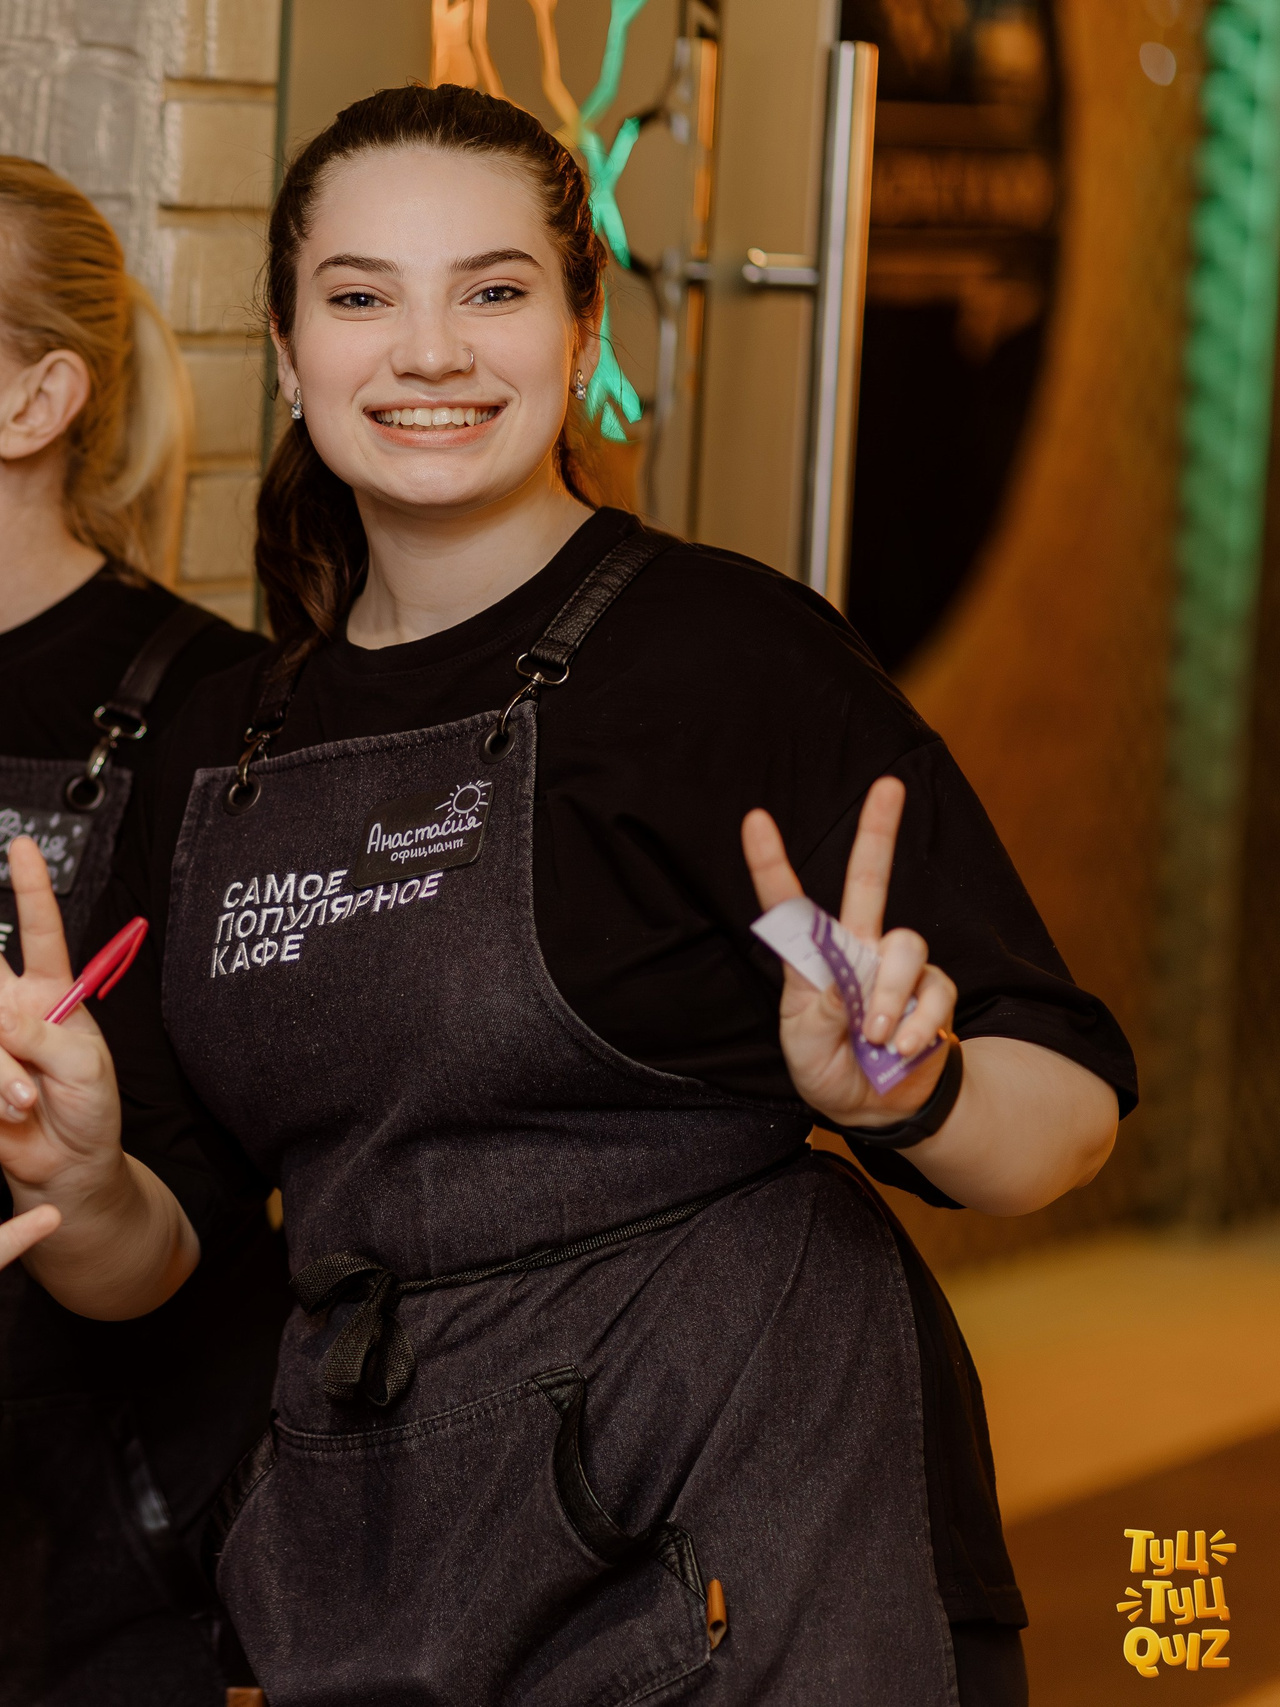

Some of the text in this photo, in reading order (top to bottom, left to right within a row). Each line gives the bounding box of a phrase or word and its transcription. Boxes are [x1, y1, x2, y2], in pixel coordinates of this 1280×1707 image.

[367, 816, 482, 854] Анастасия
[391, 838, 464, 864] официант
[215, 872, 444, 944] ПОПУЛЯРНОЕ
[223, 869, 348, 909] САМОЕ
[210, 934, 304, 978] КАФЕ
